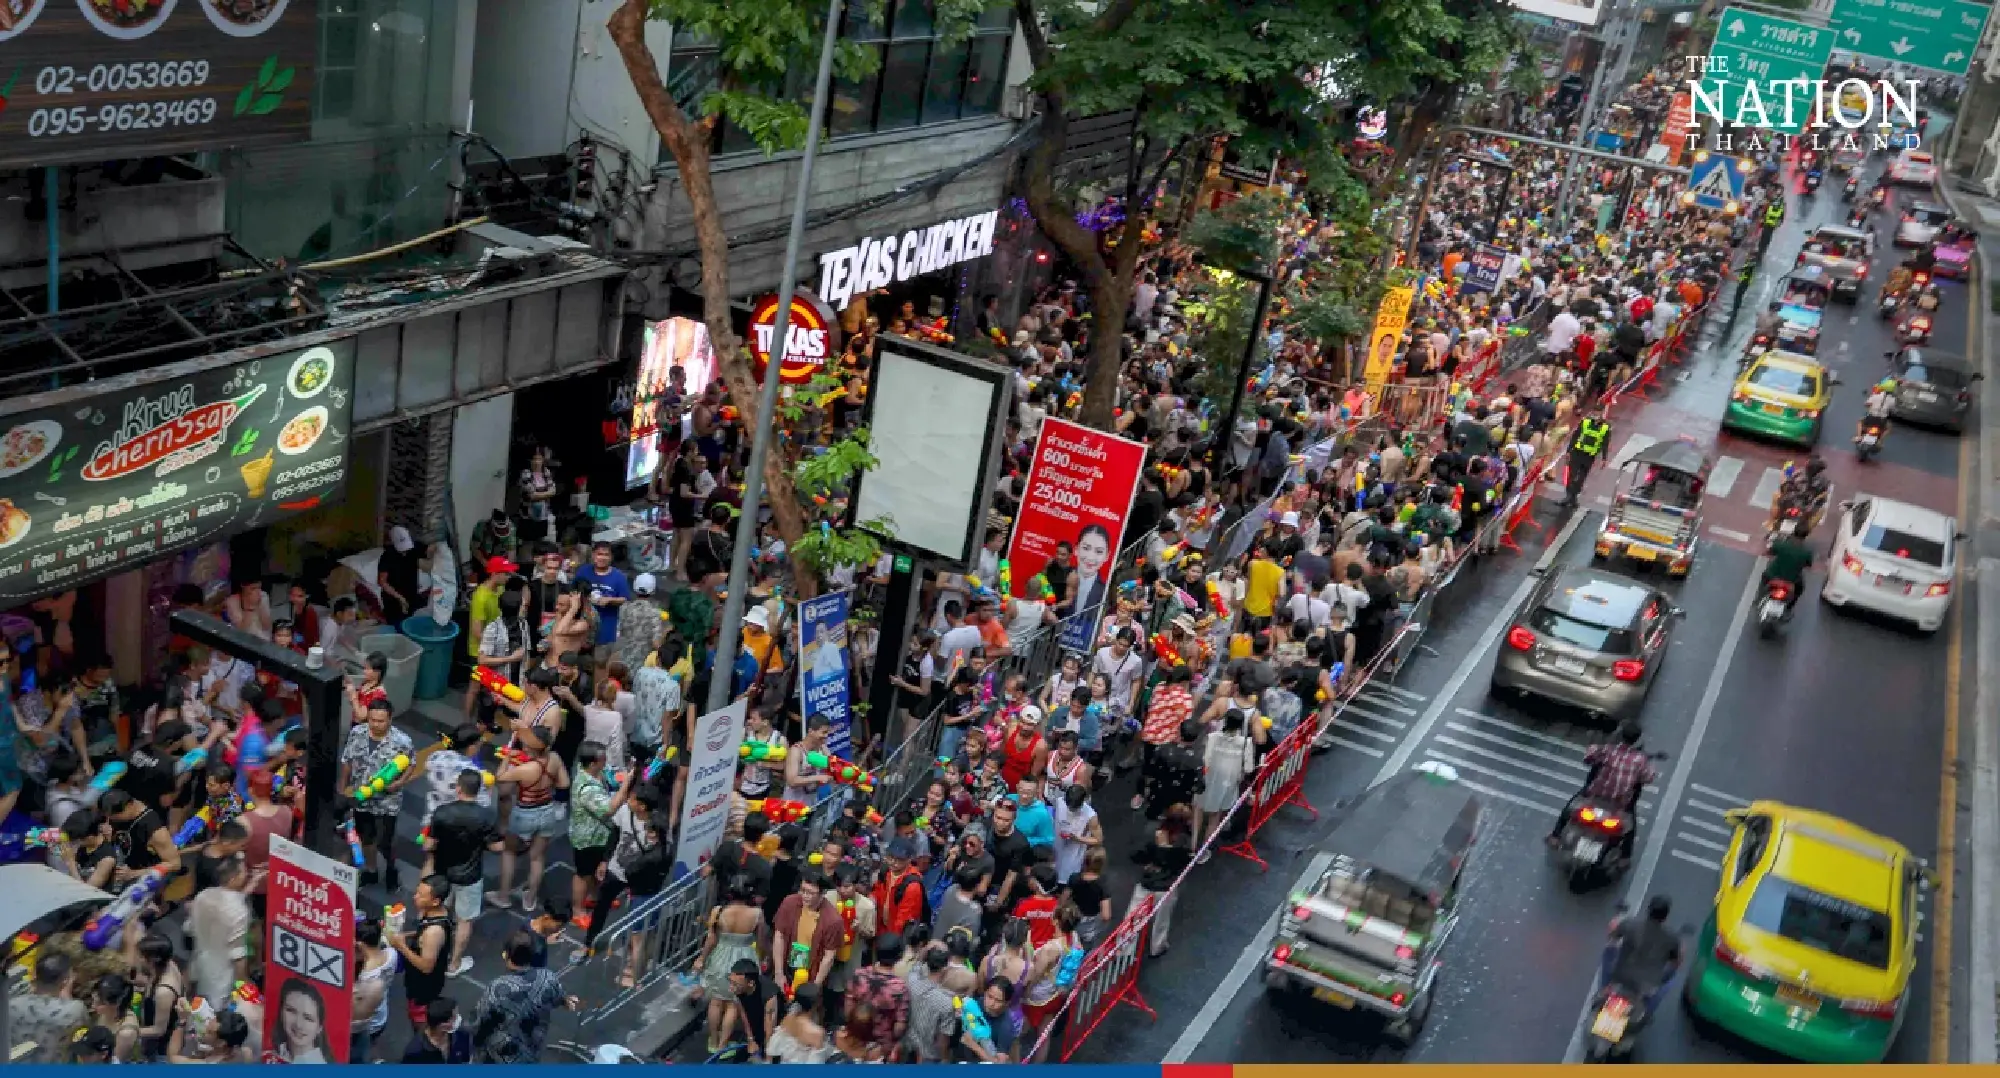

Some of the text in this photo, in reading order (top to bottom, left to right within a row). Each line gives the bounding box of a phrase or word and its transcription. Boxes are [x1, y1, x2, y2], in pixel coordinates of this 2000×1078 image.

[1761, 24, 1819, 48] ราชดำริ
[36, 60, 209, 95] 02-0053669
[1736, 52, 1770, 79] วิทยุ
[28, 97, 217, 137] 095-9623469
[820, 210, 999, 312] TEXAS CHICKEN
[122, 383, 196, 438] Krua
[1043, 447, 1071, 468] 600
[1046, 431, 1108, 462] ค่าแรงขั้นต่ำ
[1038, 466, 1095, 492] ปริญญาตรี
[1033, 482, 1082, 508] 25,000
[807, 677, 846, 704] WORK
[815, 694, 838, 712] FROM
[276, 870, 332, 906] กานต์
[285, 897, 344, 937] กนิษฐ์
[279, 932, 299, 968] 8
